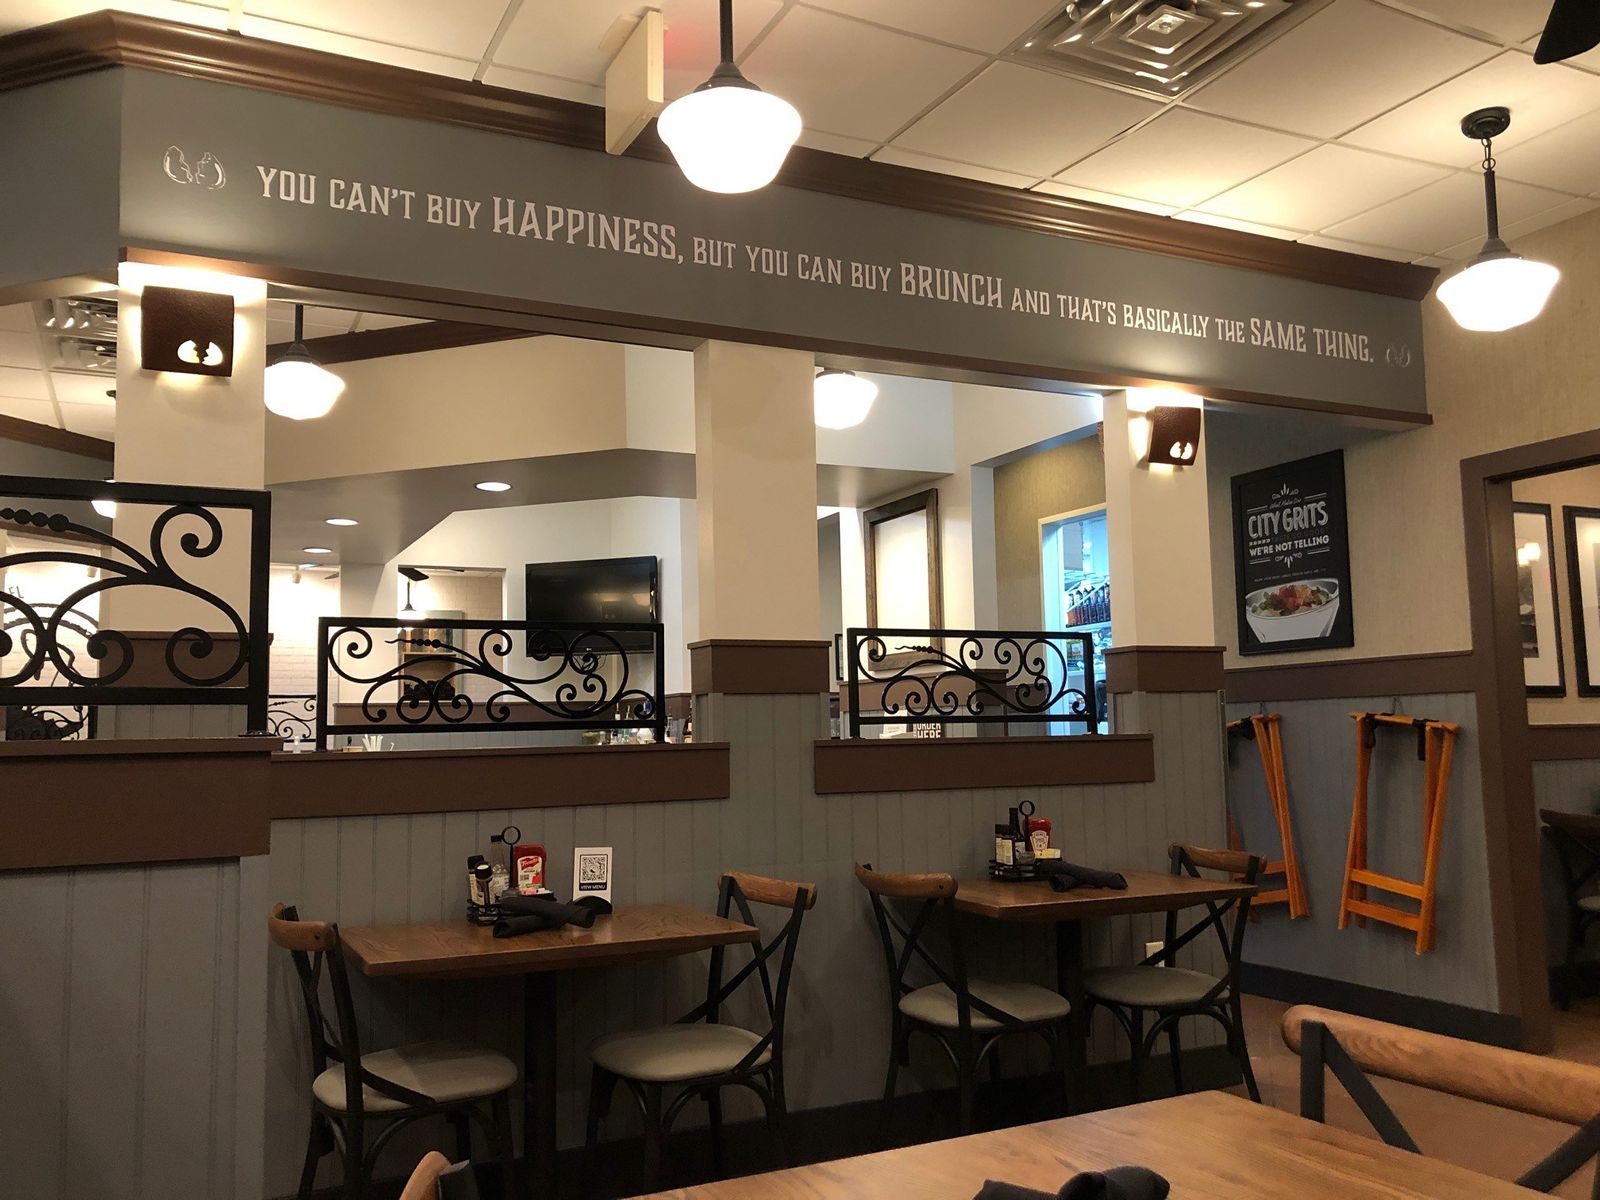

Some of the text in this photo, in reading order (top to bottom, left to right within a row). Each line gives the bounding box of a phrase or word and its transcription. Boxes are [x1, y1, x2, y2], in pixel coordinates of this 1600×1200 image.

[256, 165, 1375, 363] YOU CAN'T BUY HAPPINESS, BUT YOU CAN BUY BRUNCH AND THAT'S BASICALLY THE SAME THING.
[1248, 510, 1281, 539] CITY
[1282, 501, 1329, 533] GRITS
[1249, 544, 1274, 557] WE'RE
[1275, 541, 1293, 552] NOT
[1294, 535, 1330, 549] TELLING
